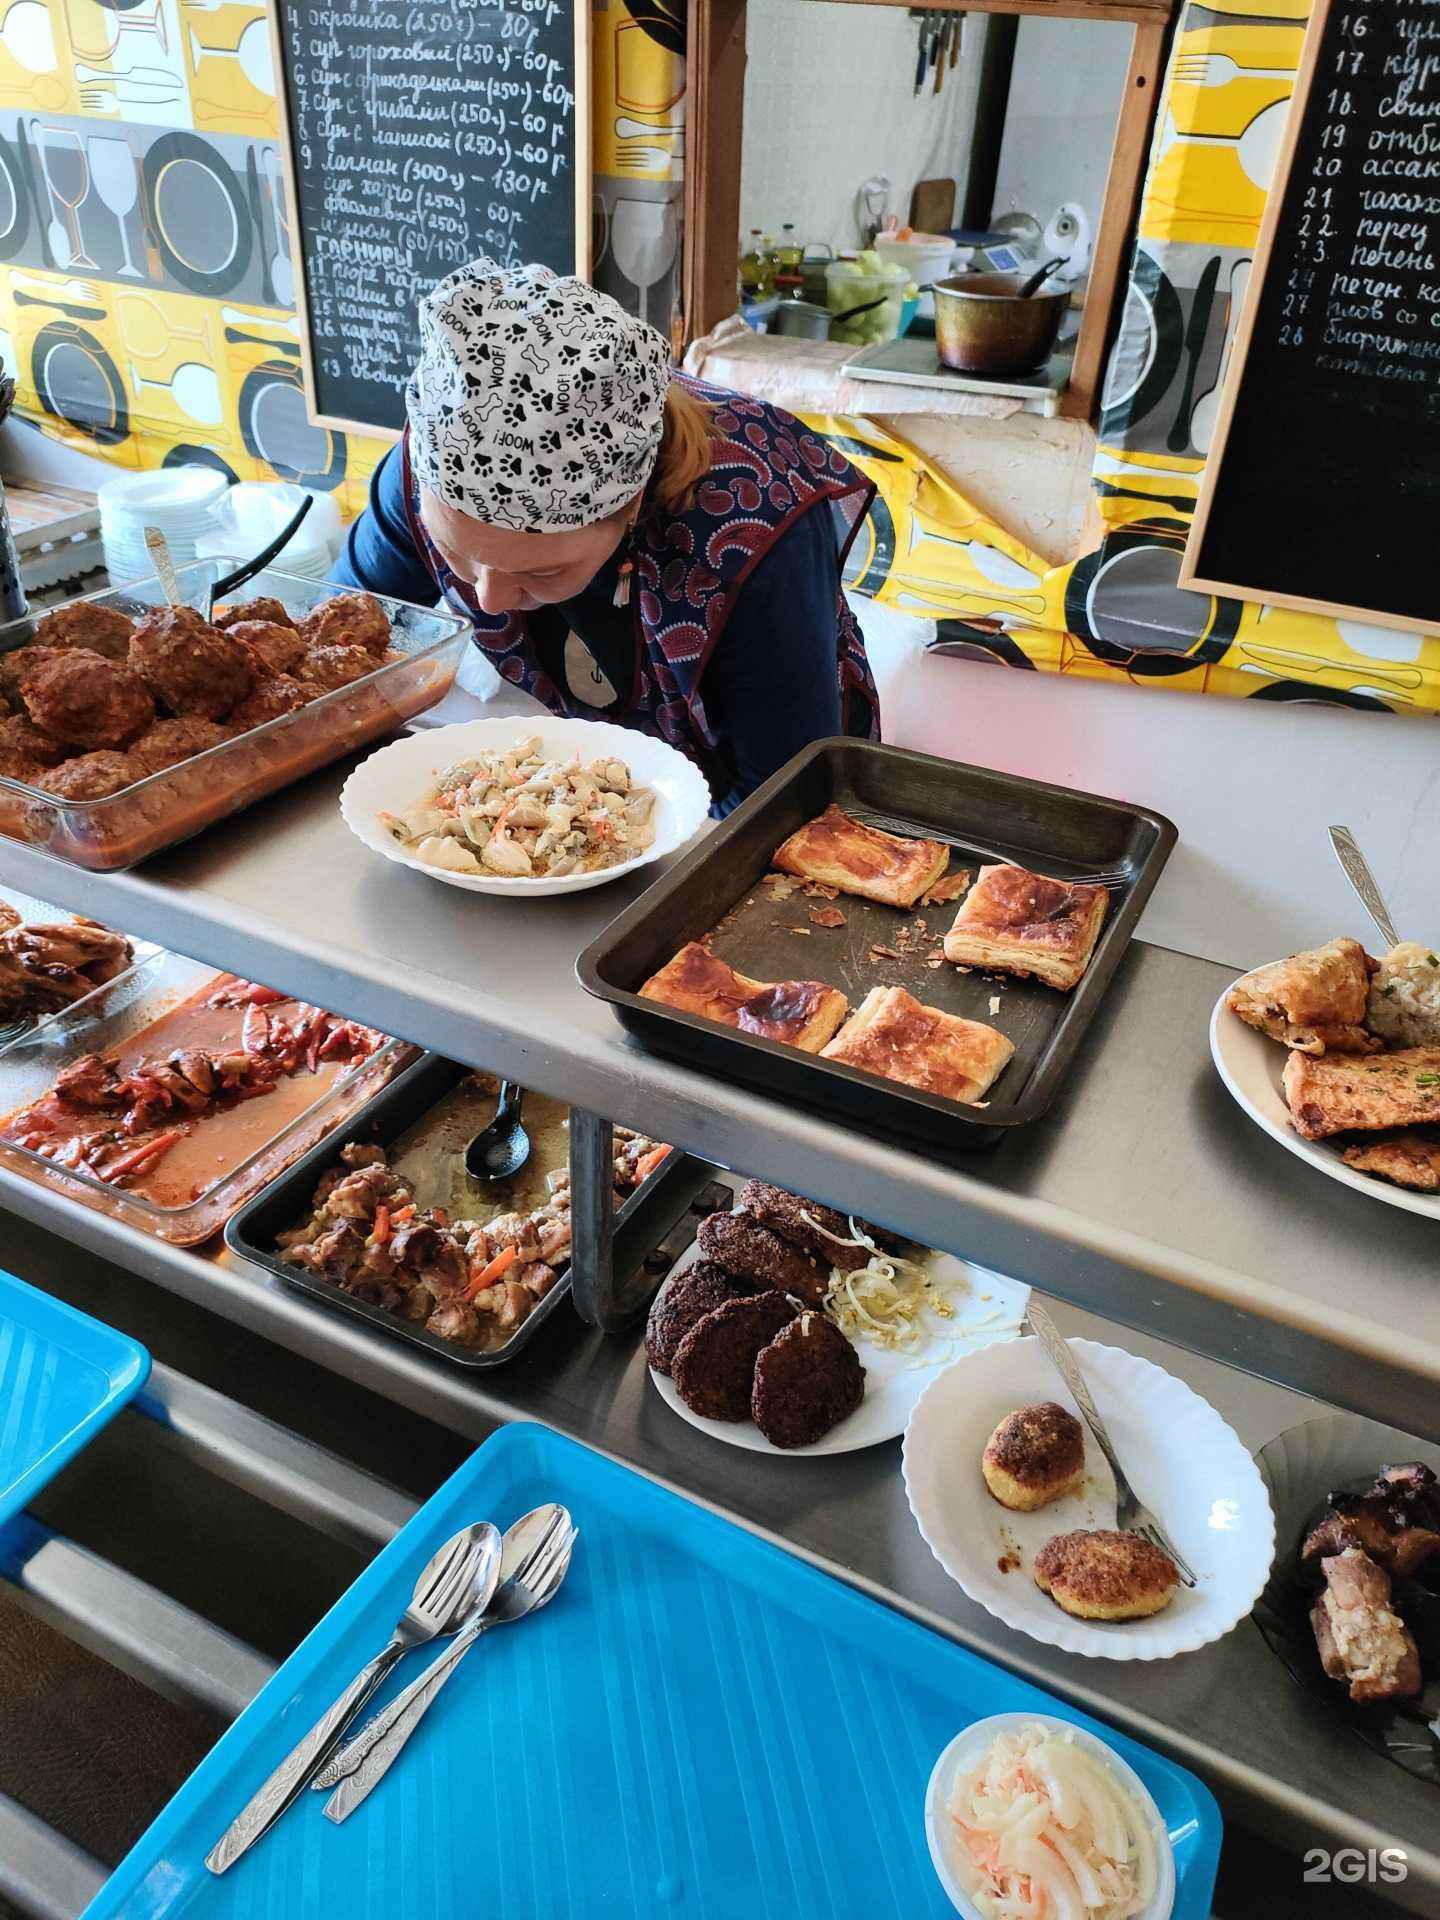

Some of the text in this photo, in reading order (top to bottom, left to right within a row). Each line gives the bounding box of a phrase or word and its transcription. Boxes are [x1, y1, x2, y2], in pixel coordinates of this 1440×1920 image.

[1355, 217, 1428, 252] перец
[1349, 243, 1435, 271] печень
[487, 298, 529, 312] WOOF!
[435, 309, 473, 342] WOOF!
[525, 311, 554, 347] WOOF!
[487, 344, 507, 389] WOOF!
[553, 373, 571, 417] WOOF!
[455, 404, 485, 448] WOOF!
[611, 407, 647, 432] WOOF!
[492, 429, 535, 457] WOOF!
[514, 488, 544, 526] WOOF!
[546, 512, 585, 527] WOOF!
